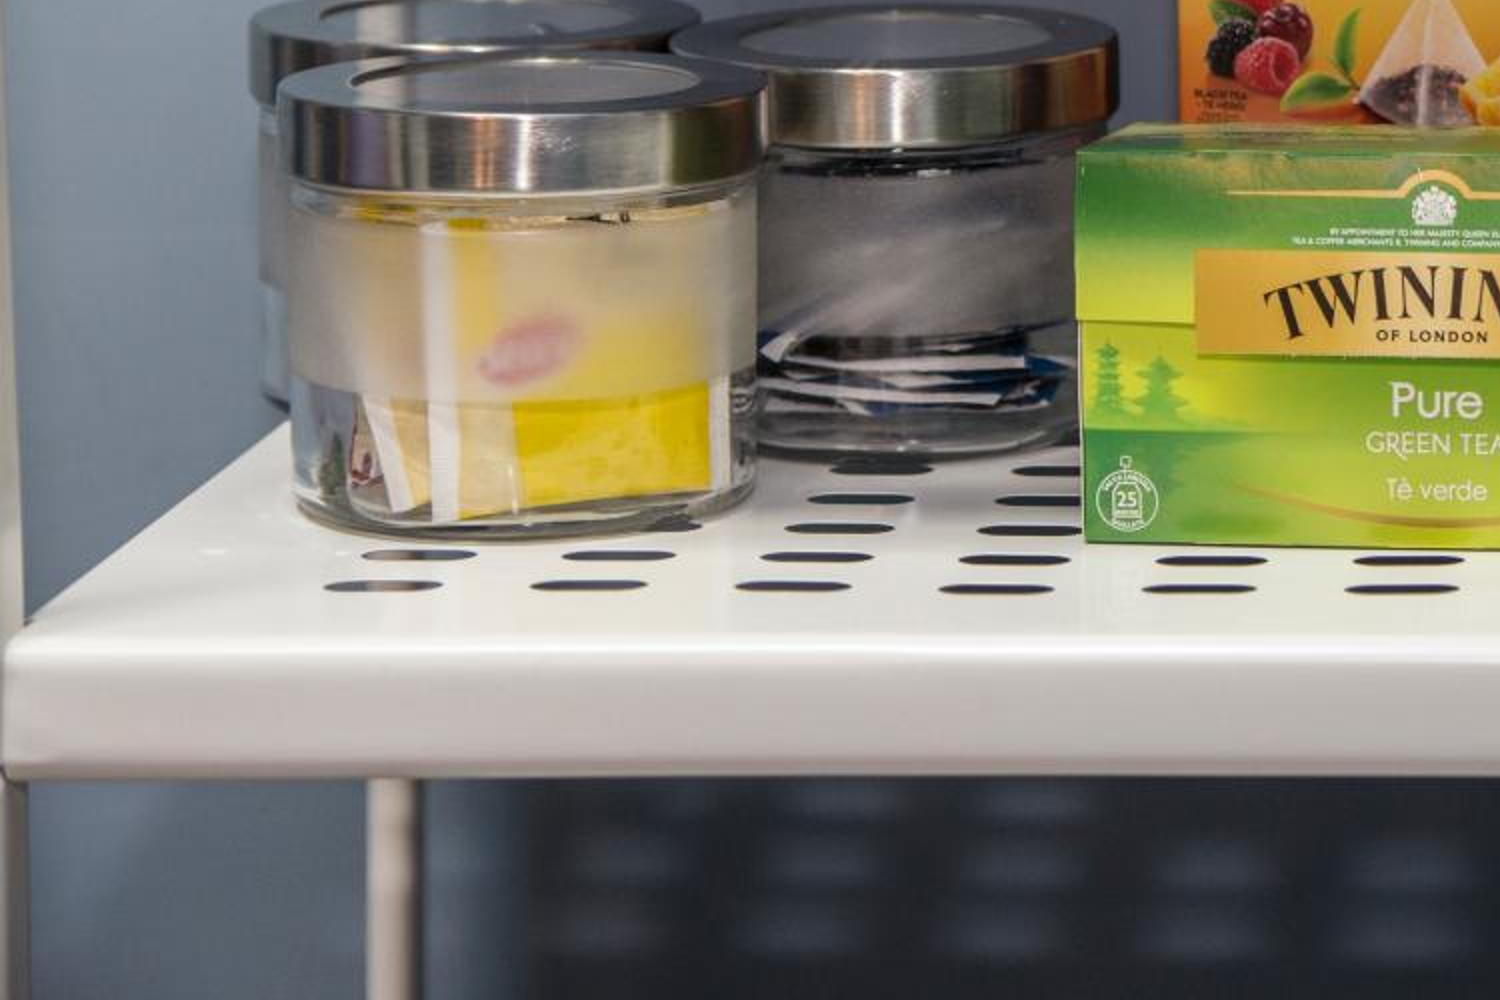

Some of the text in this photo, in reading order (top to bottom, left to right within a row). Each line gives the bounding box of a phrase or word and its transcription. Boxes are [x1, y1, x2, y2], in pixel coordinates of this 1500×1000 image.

[1376, 330, 1488, 344] OF LONDON
[1390, 381, 1484, 420] Pure
[1365, 430, 1451, 462] GREEN
[1117, 491, 1137, 507] 25
[1420, 480, 1488, 502] verde
